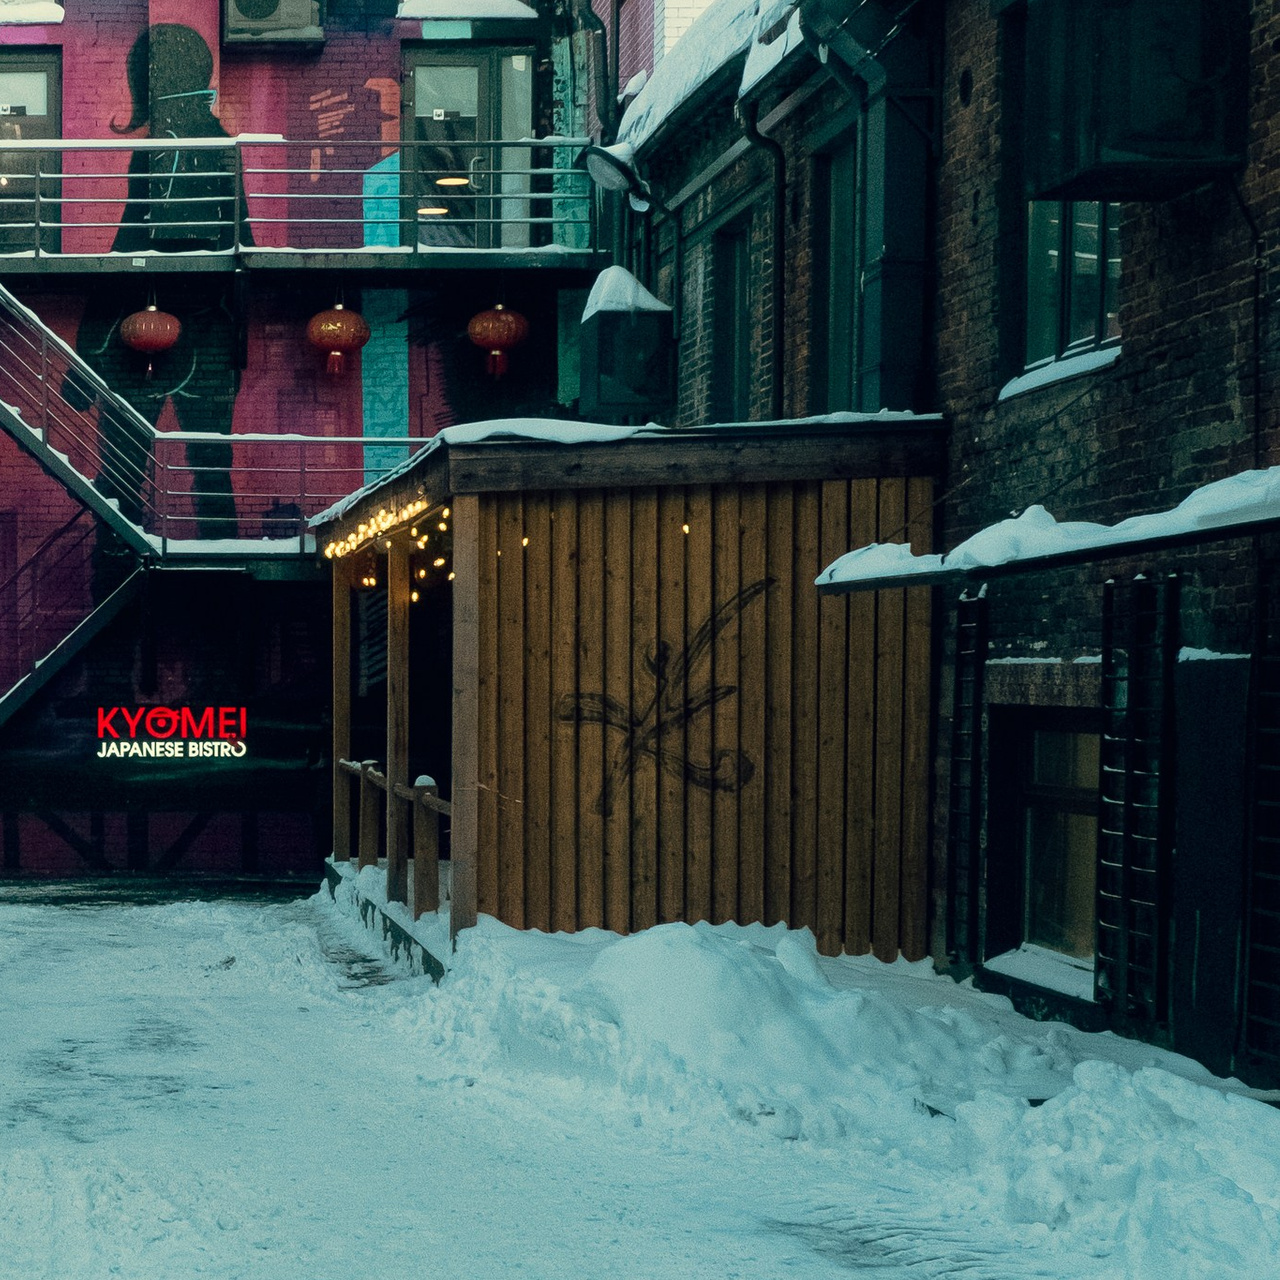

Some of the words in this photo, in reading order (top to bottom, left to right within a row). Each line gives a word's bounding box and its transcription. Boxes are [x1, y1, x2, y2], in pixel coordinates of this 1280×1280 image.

[97, 706, 247, 739] KYOMEI
[97, 741, 184, 758] JAPANESE
[189, 741, 247, 758] BISTRO
